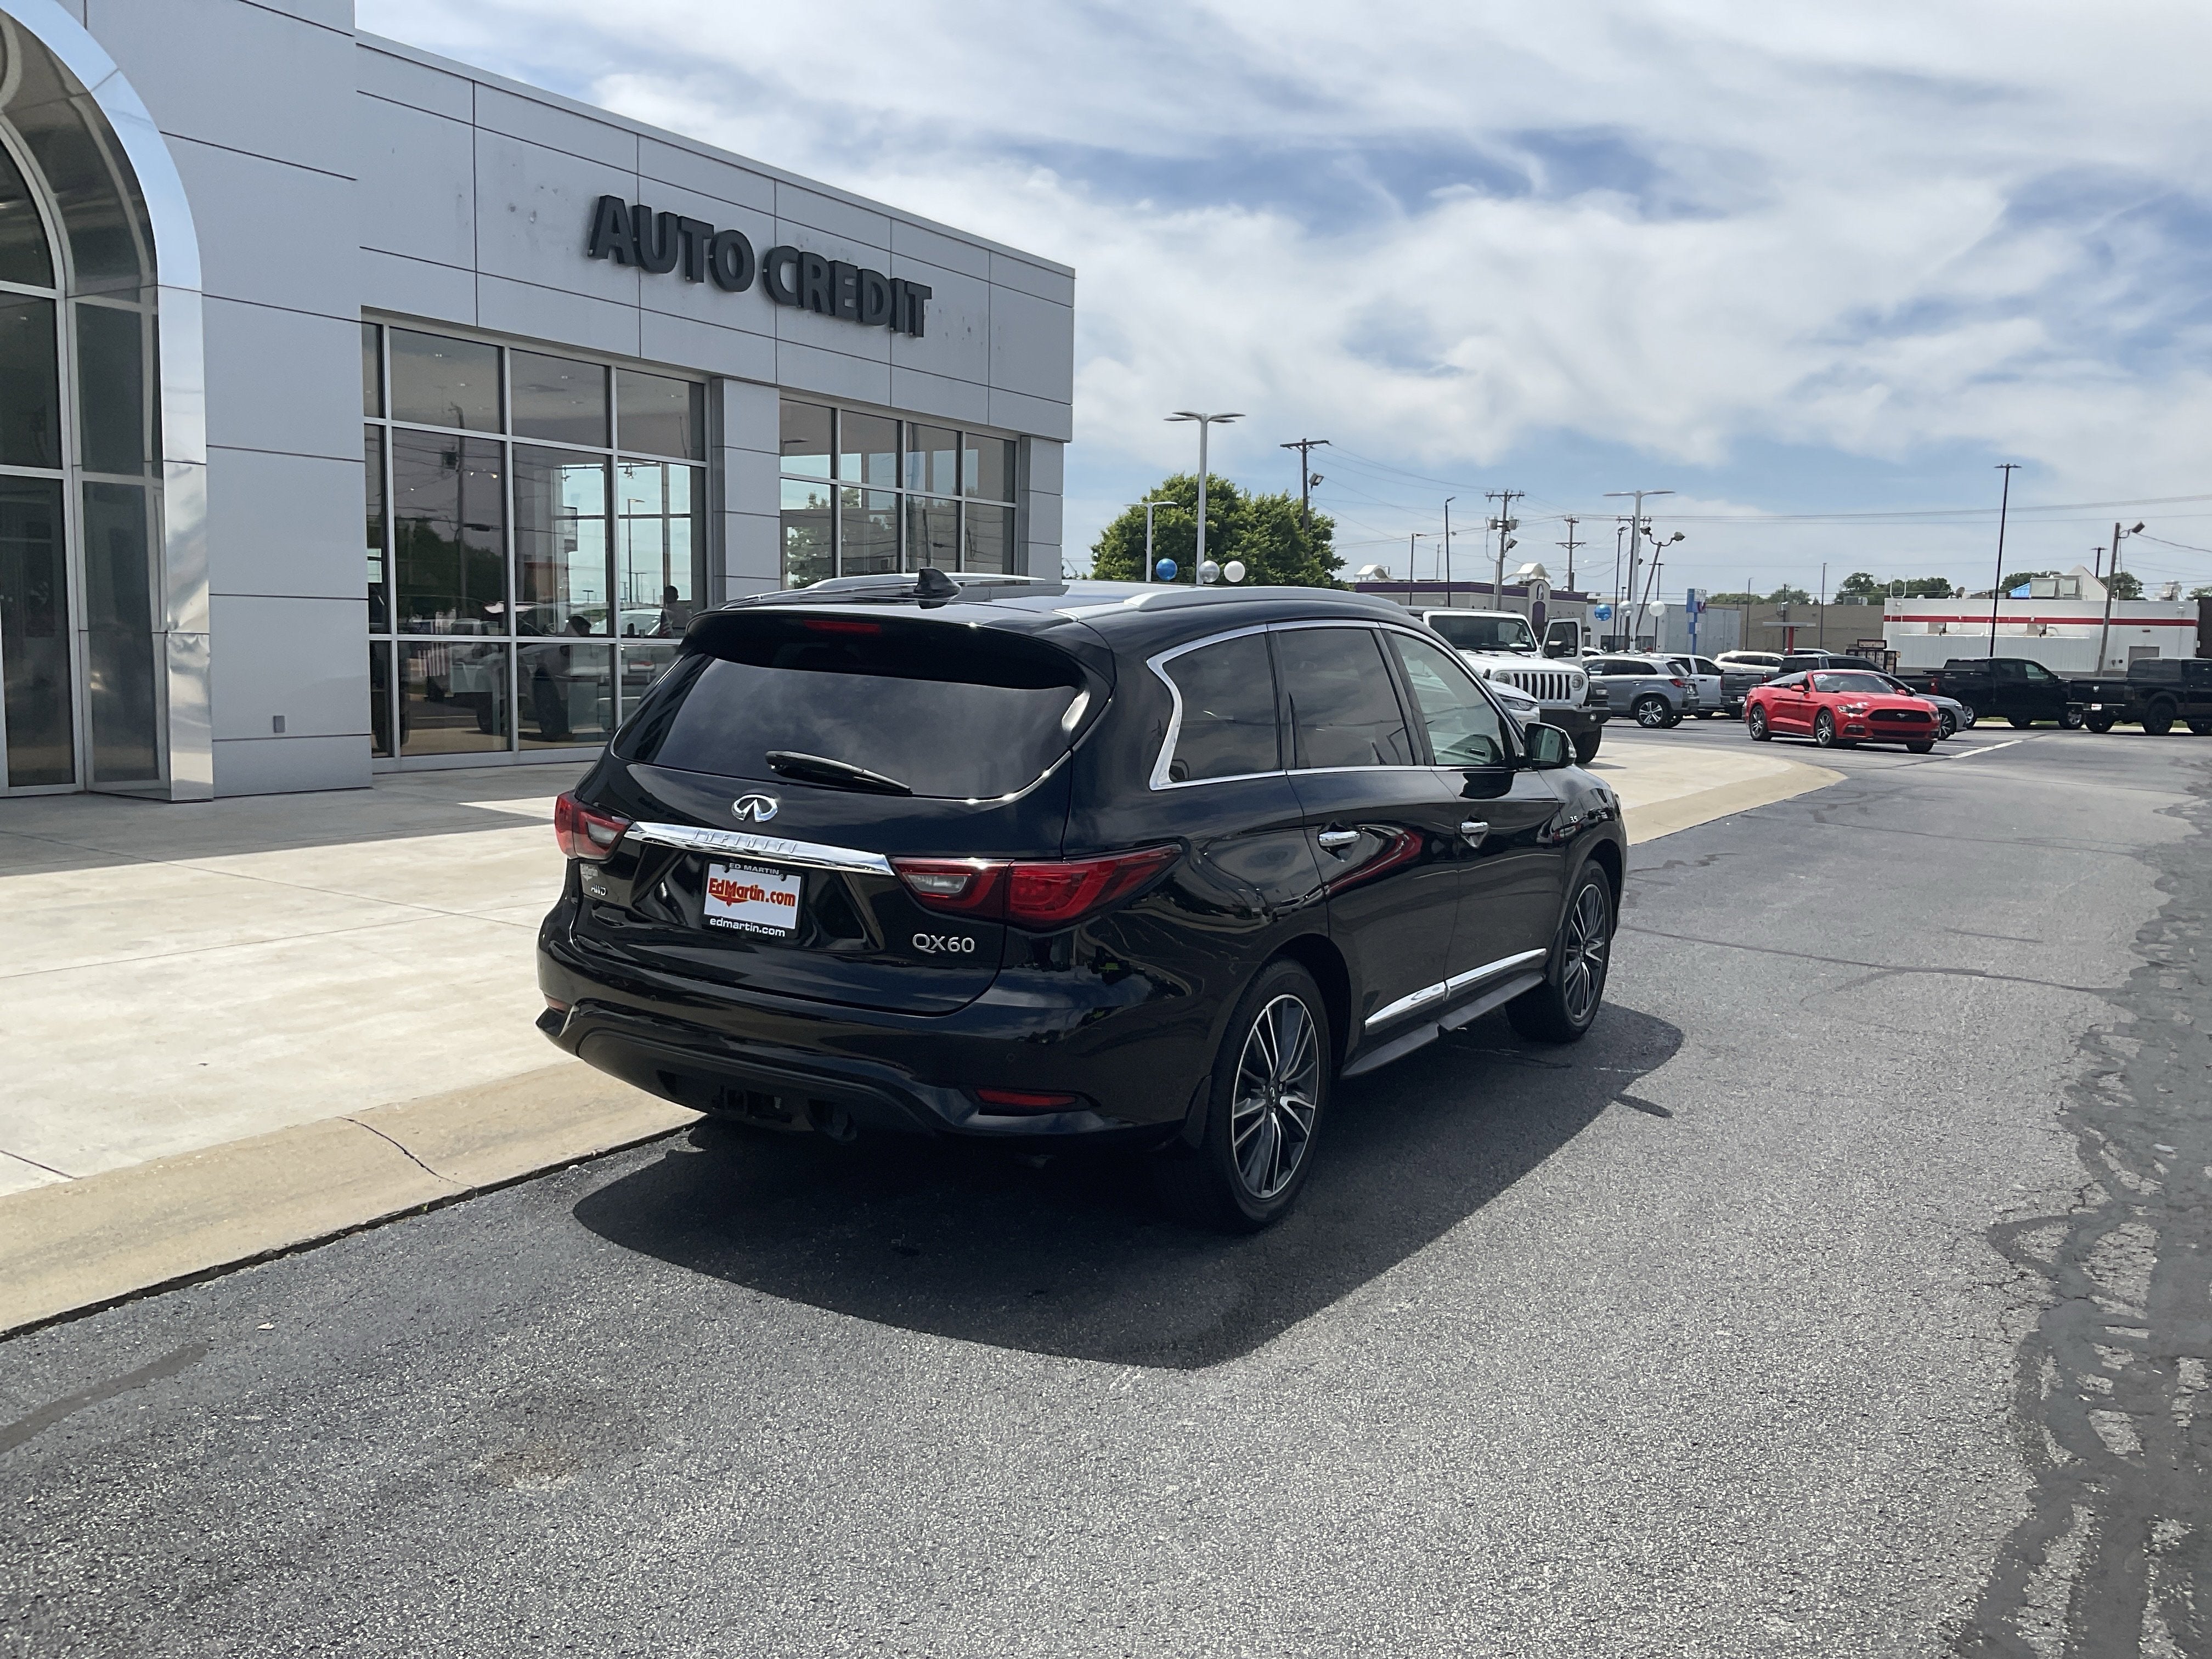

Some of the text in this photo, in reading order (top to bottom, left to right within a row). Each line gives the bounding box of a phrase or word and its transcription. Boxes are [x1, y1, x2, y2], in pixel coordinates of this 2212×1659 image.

[587, 195, 932, 337] AUTO CREDIT
[693, 829, 798, 854] INFINITI
[744, 865, 780, 876] MARTIN
[708, 878, 796, 907] EdMartin.com
[709, 918, 786, 937] edmartin.com
[912, 933, 975, 953] QX60
